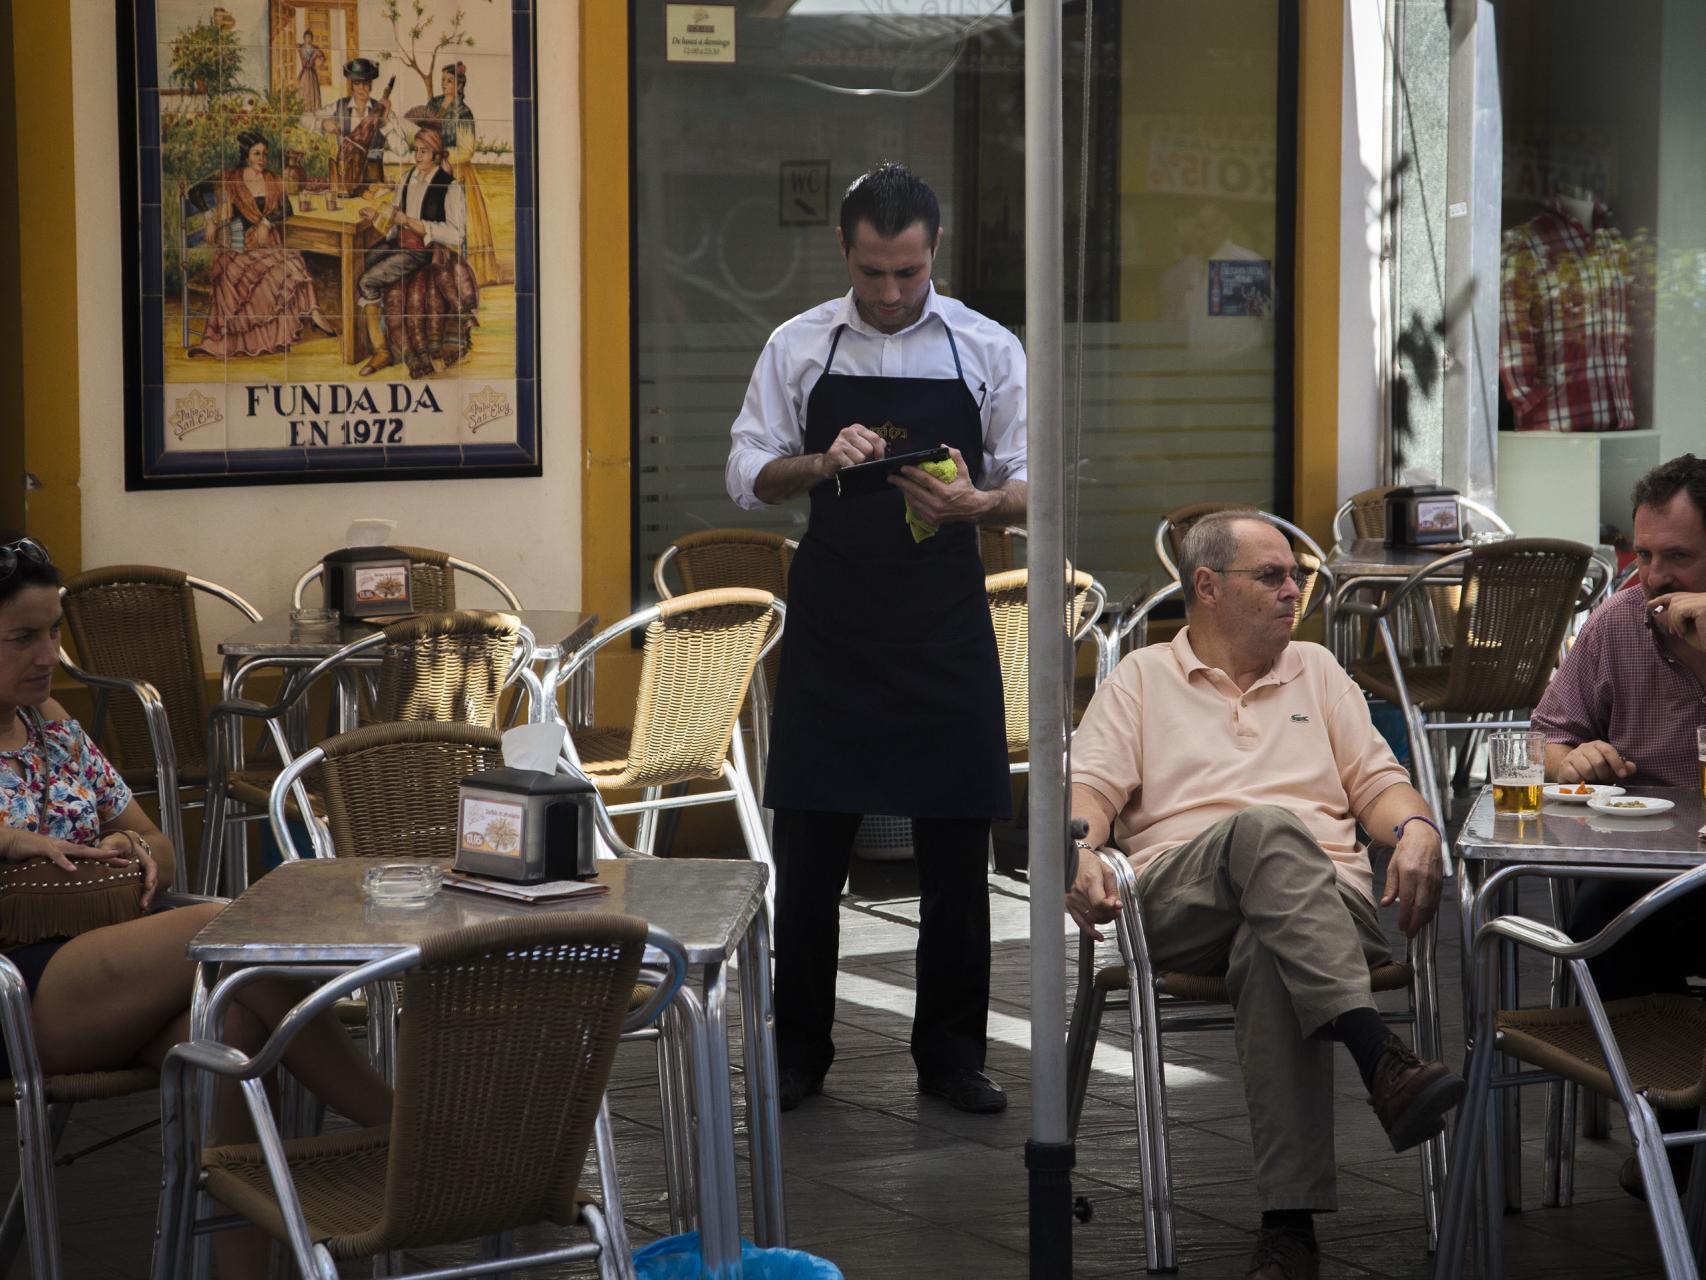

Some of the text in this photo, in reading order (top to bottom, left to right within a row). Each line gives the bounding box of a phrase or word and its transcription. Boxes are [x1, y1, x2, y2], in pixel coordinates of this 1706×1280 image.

[791, 170, 821, 193] WC
[289, 417, 404, 447] EN 1972
